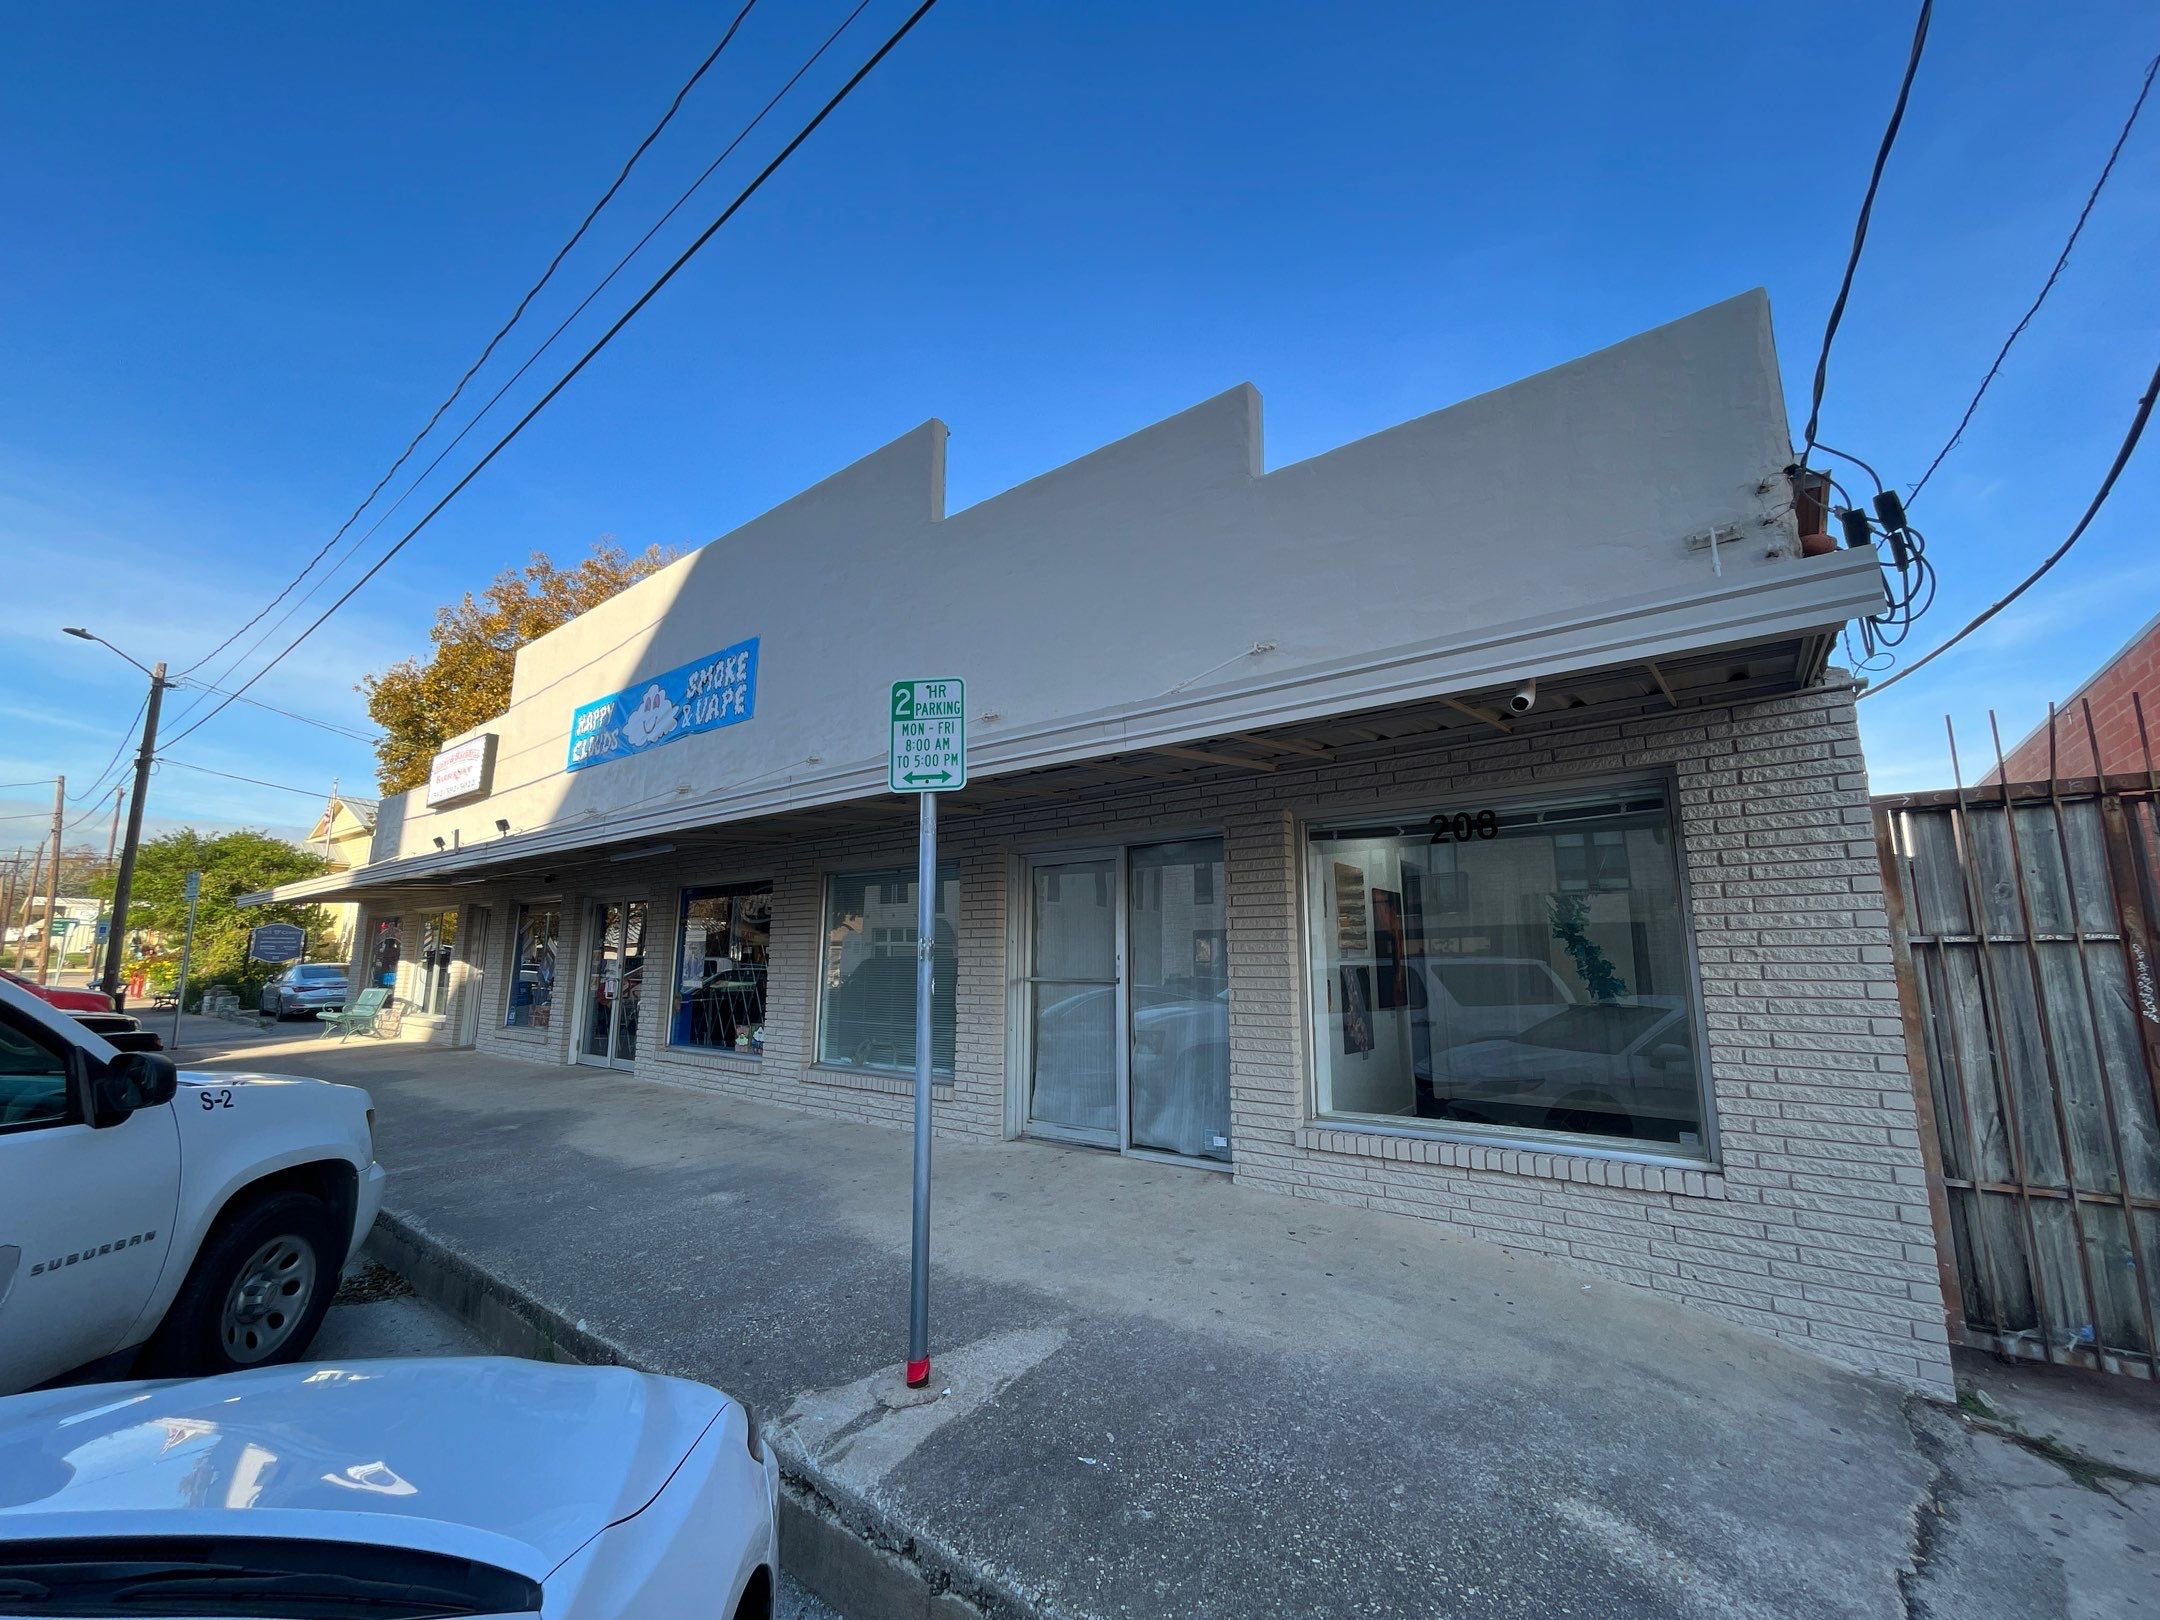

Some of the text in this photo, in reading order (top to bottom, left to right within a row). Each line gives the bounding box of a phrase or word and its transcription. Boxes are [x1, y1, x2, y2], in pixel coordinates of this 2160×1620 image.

[687, 650, 750, 699] SMOKE
[681, 684, 748, 729] & VAPE
[895, 684, 947, 716] 2 HR
[915, 700, 960, 716] PARKING
[902, 723, 925, 737] MON
[938, 721, 955, 735] FRI
[905, 737, 950, 752] 8:00 AM
[897, 753, 959, 769] TO 5:00 PM
[1429, 809, 1498, 845] 208
[200, 1090, 235, 1111] S-2
[30, 1230, 157, 1277] SUBURBAN
